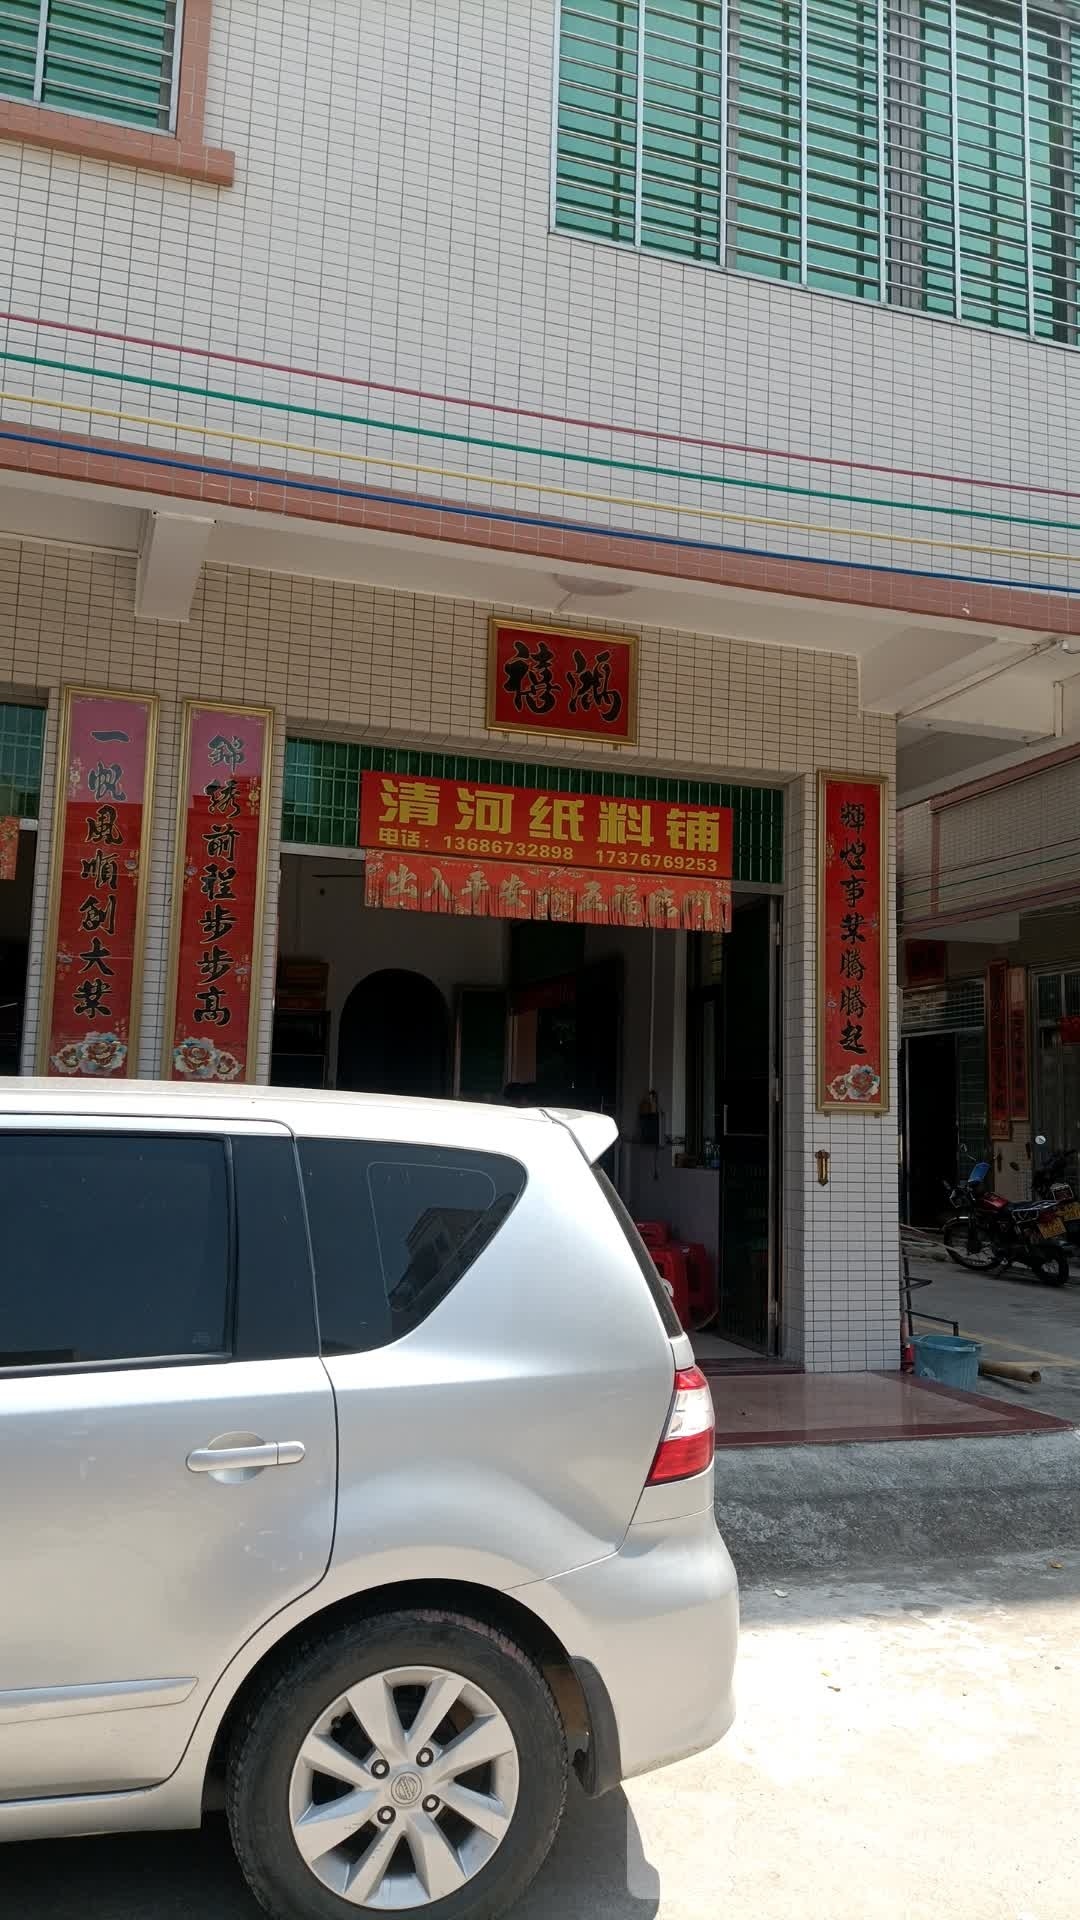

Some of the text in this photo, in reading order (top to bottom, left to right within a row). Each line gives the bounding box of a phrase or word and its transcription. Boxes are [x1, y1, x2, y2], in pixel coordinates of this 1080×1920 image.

[378, 778, 721, 853] 清河纸料铺
[443, 834, 575, 861] 13686732898
[595, 849, 719, 873] 17376769253
